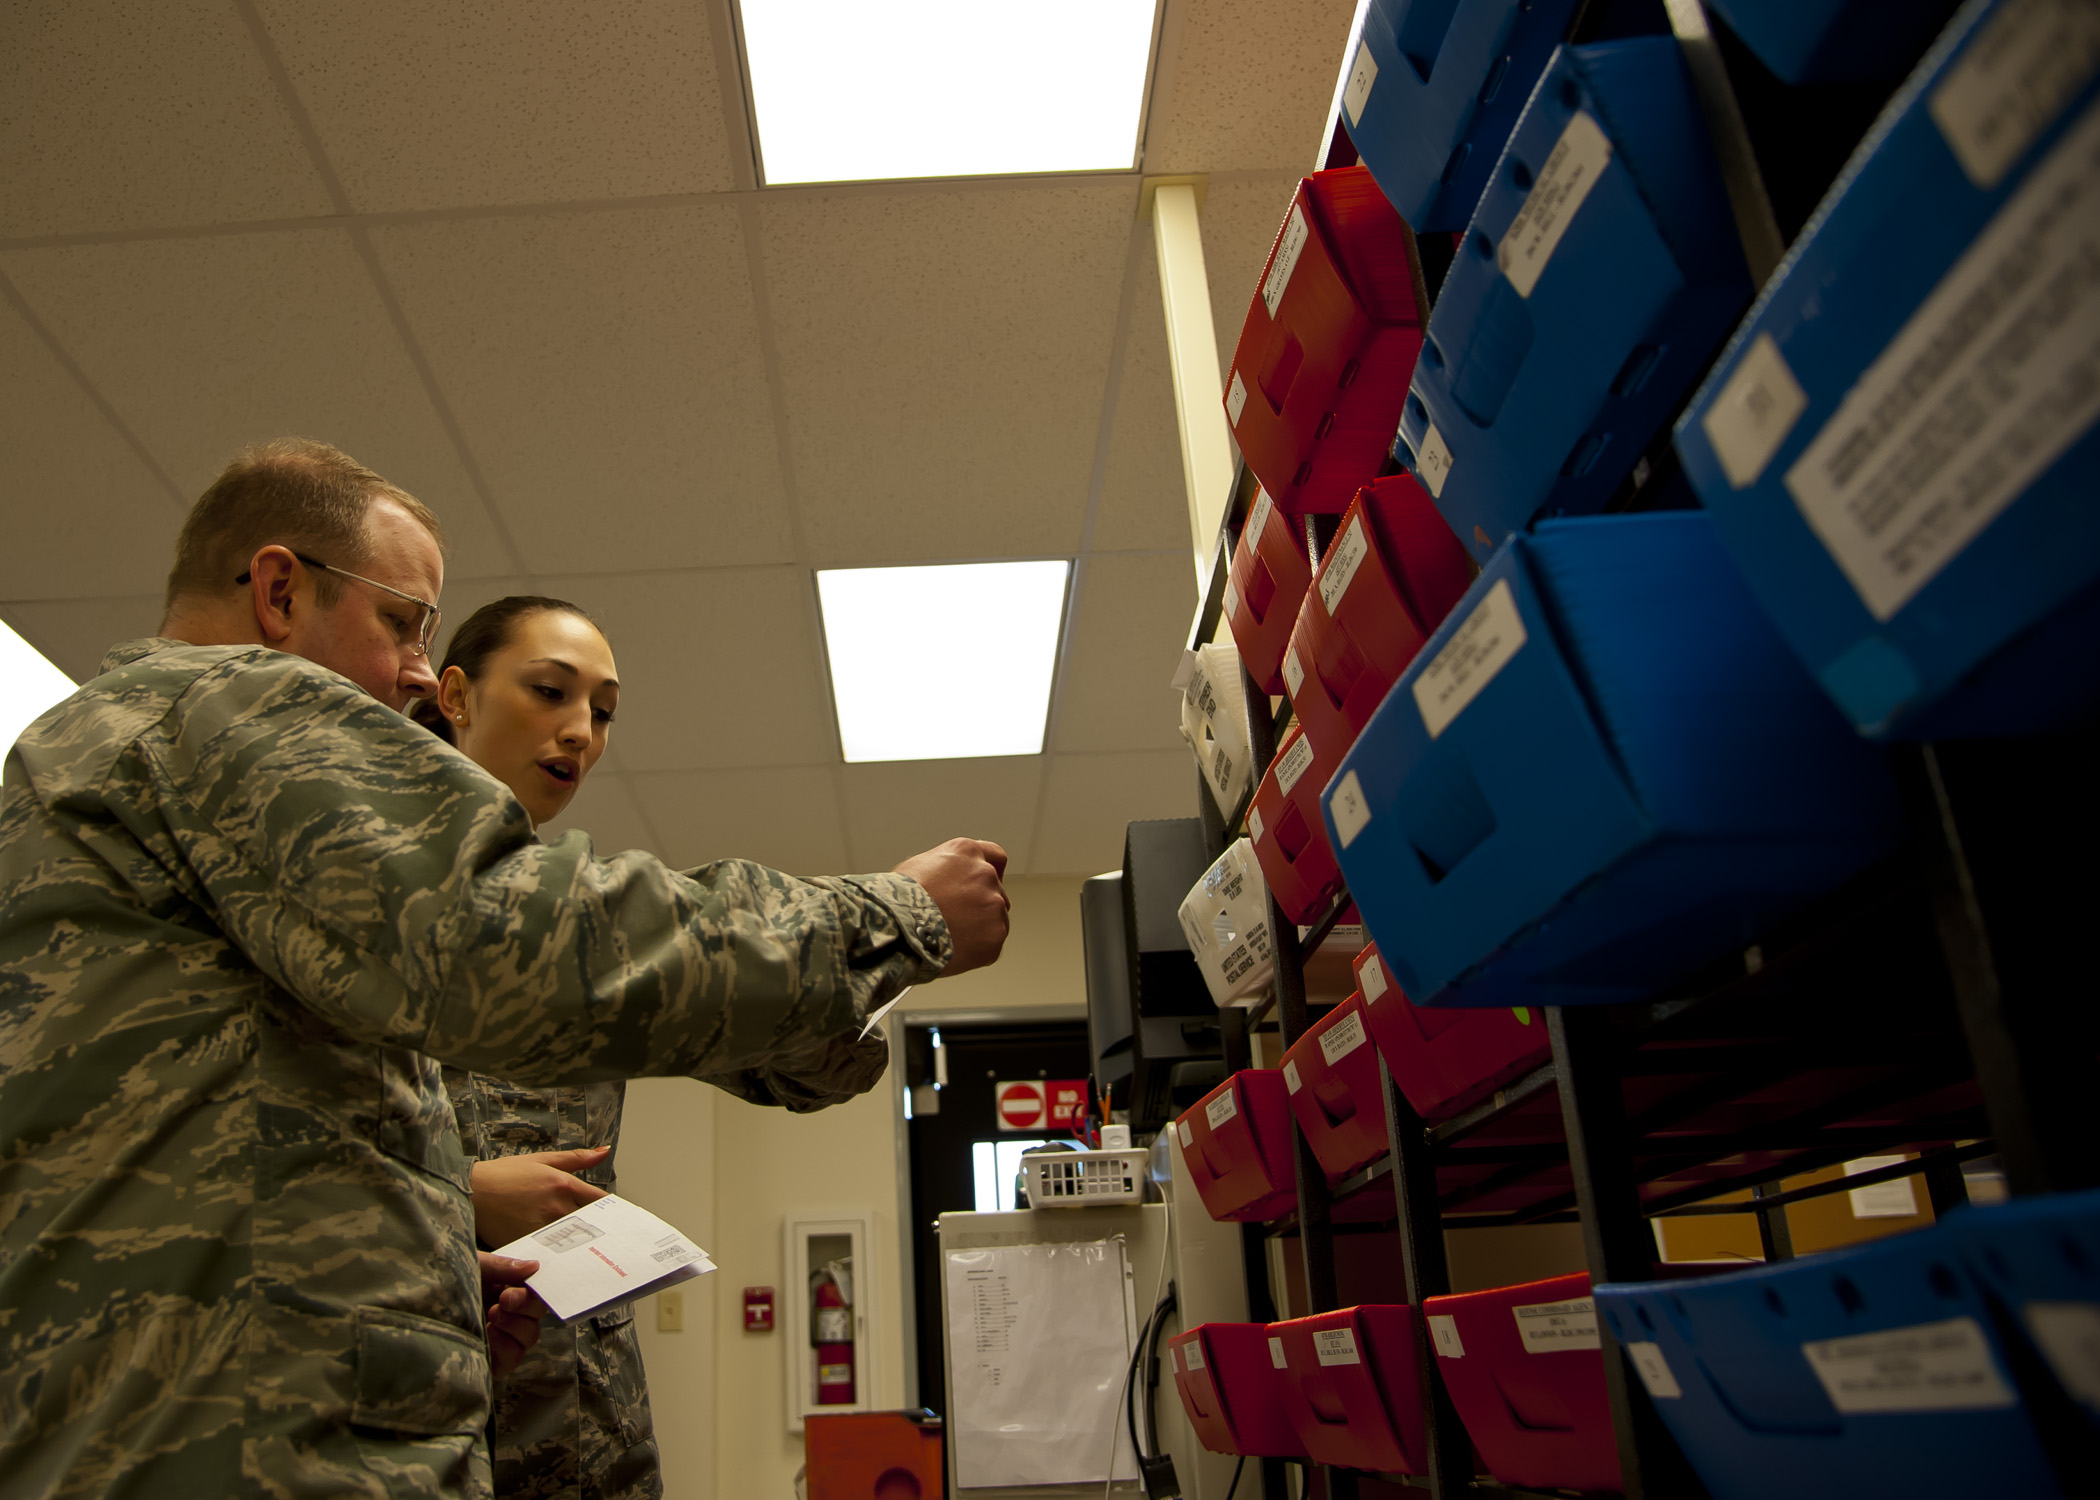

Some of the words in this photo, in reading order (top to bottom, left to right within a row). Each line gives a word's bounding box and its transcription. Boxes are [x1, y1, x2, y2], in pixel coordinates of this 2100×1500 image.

[1199, 681, 1212, 711] OTHER
[1206, 698, 1216, 719] END
[1230, 873, 1243, 889] WEIGHT
[1220, 955, 1233, 974] UNITED
[1231, 944, 1248, 964] STATES
[1225, 966, 1241, 986] POSTAL
[1237, 955, 1255, 973] SERVICE
[1370, 967, 1377, 984] 17
[1057, 1090, 1078, 1103] NO
[1441, 1330, 1451, 1345] 18
